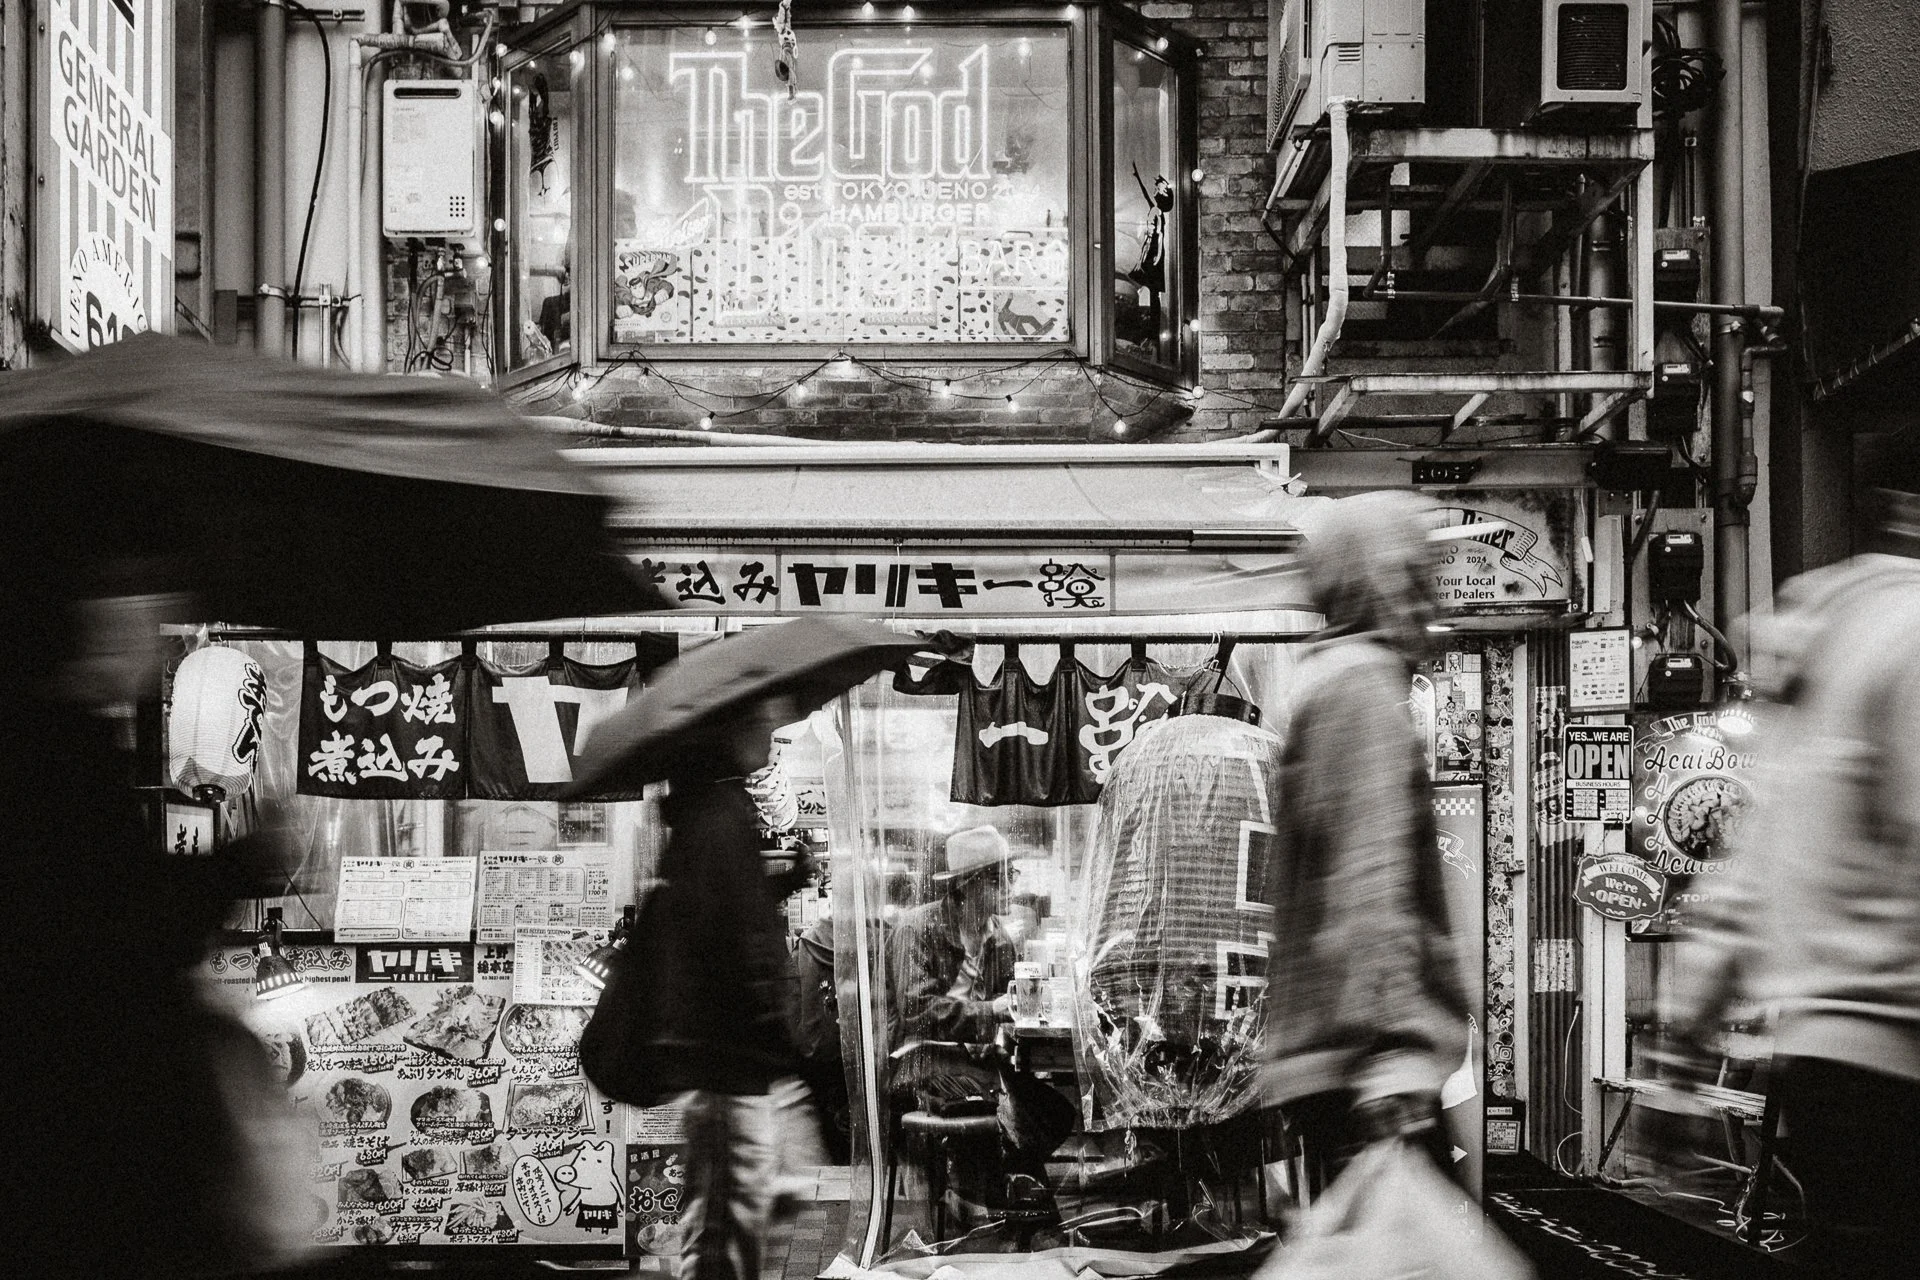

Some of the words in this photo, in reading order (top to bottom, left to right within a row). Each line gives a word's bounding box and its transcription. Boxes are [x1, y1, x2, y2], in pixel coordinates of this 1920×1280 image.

[59, 30, 161, 186] GENERAL
[669, 50, 825, 183] The
[828, 44, 991, 183] God
[64, 95, 156, 232] GARDEN
[830, 203, 990, 223] HAMBURGER
[960, 240, 1037, 278] BAR
[1466, 556, 1487, 564] 2024
[1436, 575, 1463, 586] Your
[1466, 575, 1496, 586] Local
[1454, 589, 1495, 599] Dealers
[309, 672, 457, 724] もつ焼
[1662, 716, 1690, 732] The
[1609, 731, 1629, 742] ARE
[307, 729, 460, 786] 煮込み
[1567, 743, 1630, 779] OPEN
[1600, 864, 1648, 885] WELCOME
[1604, 876, 1639, 894] We're
[1595, 889, 1642, 910] OPEN
[367, 948, 463, 973] ヤリキ
[393, 973, 436, 982] YARIKI
[582, 1209, 612, 1220] ヤリキ
